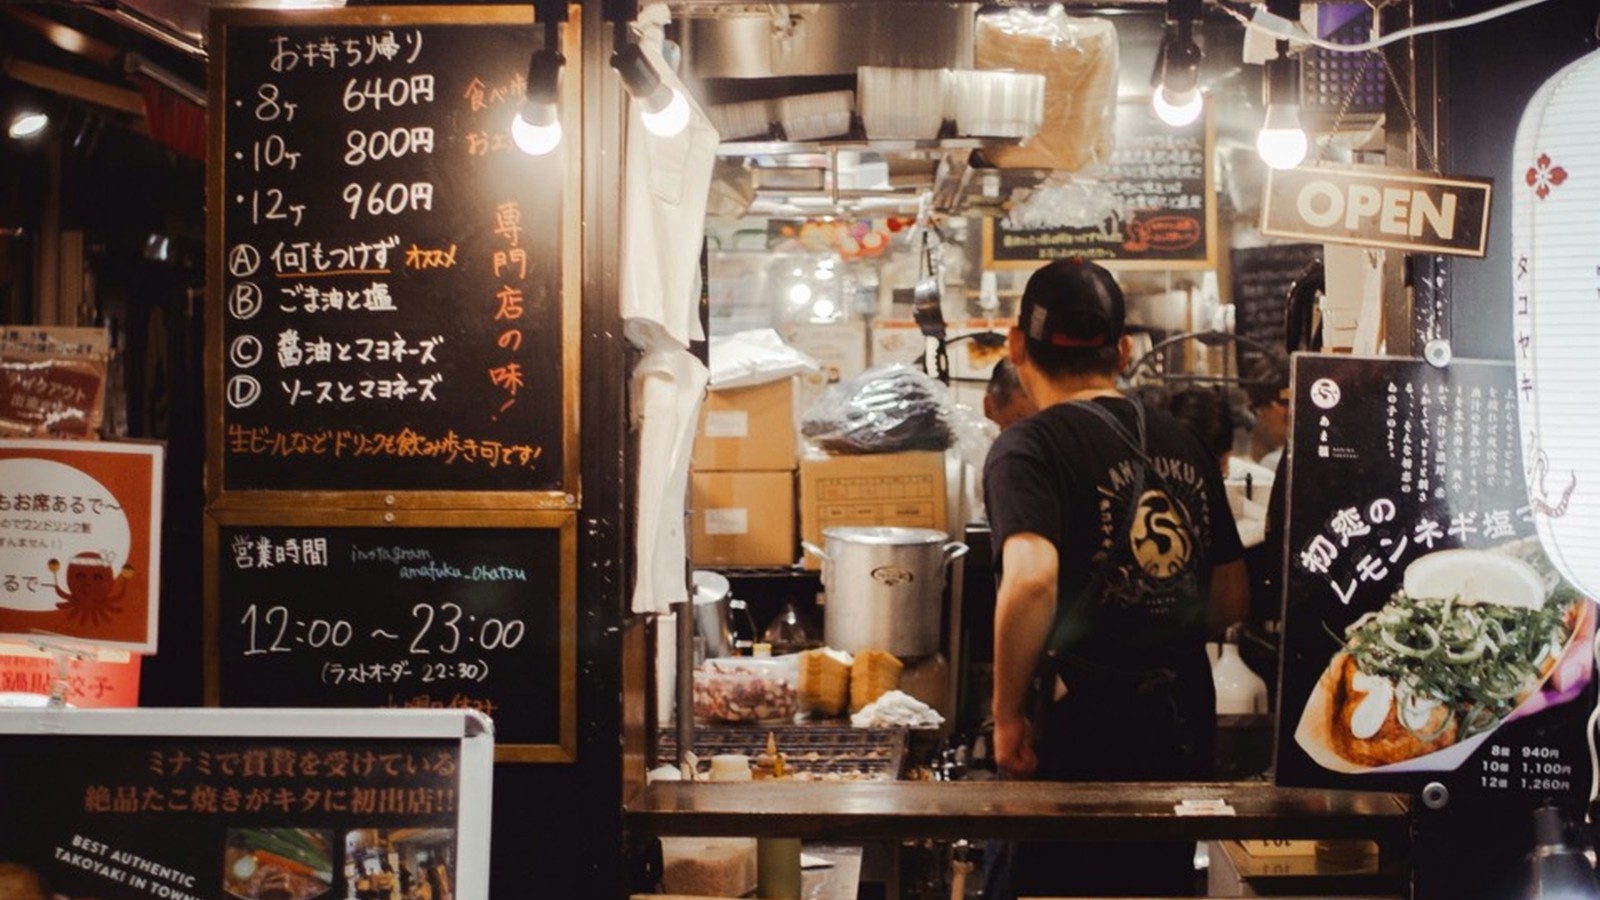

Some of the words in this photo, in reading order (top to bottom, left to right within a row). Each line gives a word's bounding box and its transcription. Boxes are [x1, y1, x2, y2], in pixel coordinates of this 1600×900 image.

[270, 30, 422, 72] お持ち帰り
[343, 75, 434, 111] 640円
[343, 127, 434, 166] 800円
[343, 182, 434, 220] 960円
[1297, 180, 1457, 241] OPEN
[270, 235, 399, 272] 何もつけず
[280, 282, 397, 312] ごま油と塩
[1516, 256, 1532, 402] タコヤキ
[282, 374, 443, 406] ソースとマヨネーズ
[232, 535, 328, 568] 営業時間
[241, 604, 352, 656] 12:00
[409, 603, 525, 654] 23:00
[150, 751, 456, 777] ミナミで賞賛を受けている
[1522, 746, 1559, 759] 940円
[54, 847, 126, 882] TAKOYAKI
[129, 874, 147, 890] IN
[72, 834, 109, 856] BEST
[110, 850, 196, 888] AUTHENTIC
